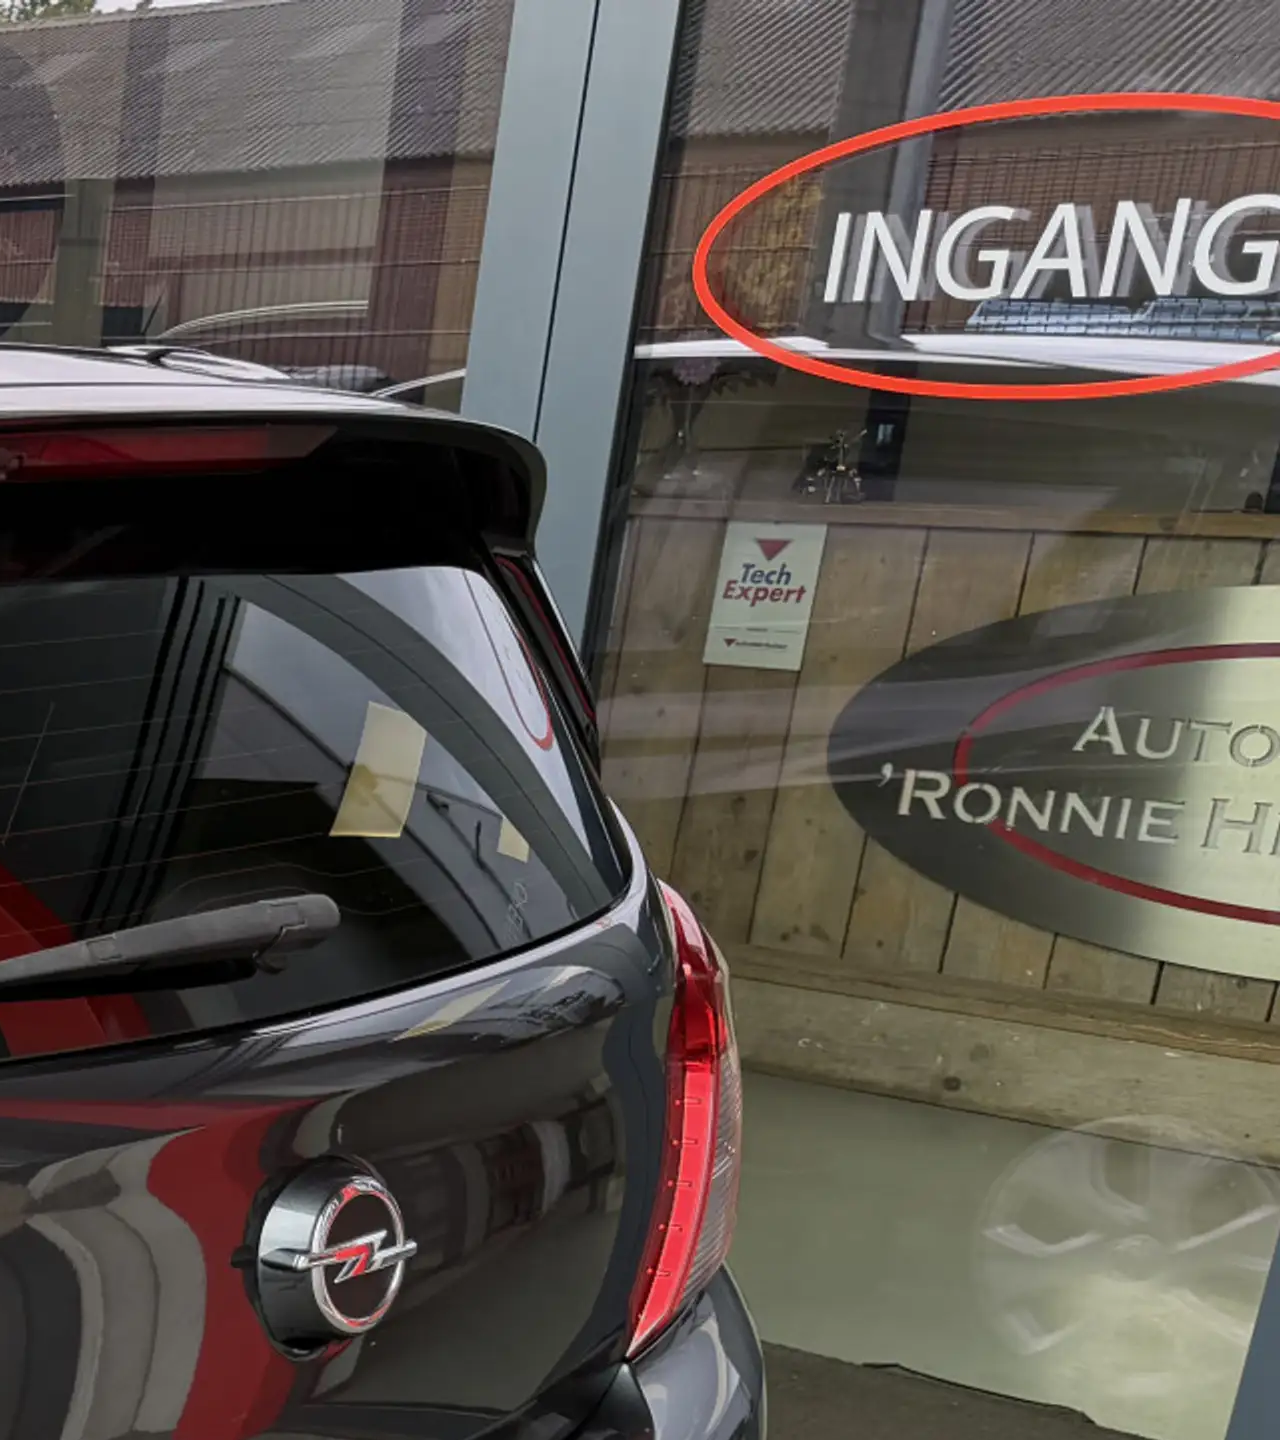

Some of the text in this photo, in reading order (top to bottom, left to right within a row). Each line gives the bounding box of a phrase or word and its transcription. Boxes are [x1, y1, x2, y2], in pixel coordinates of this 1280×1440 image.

[823, 193, 1280, 302] INGANG
[740, 562, 792, 586] Tech
[722, 579, 807, 607] Expert
